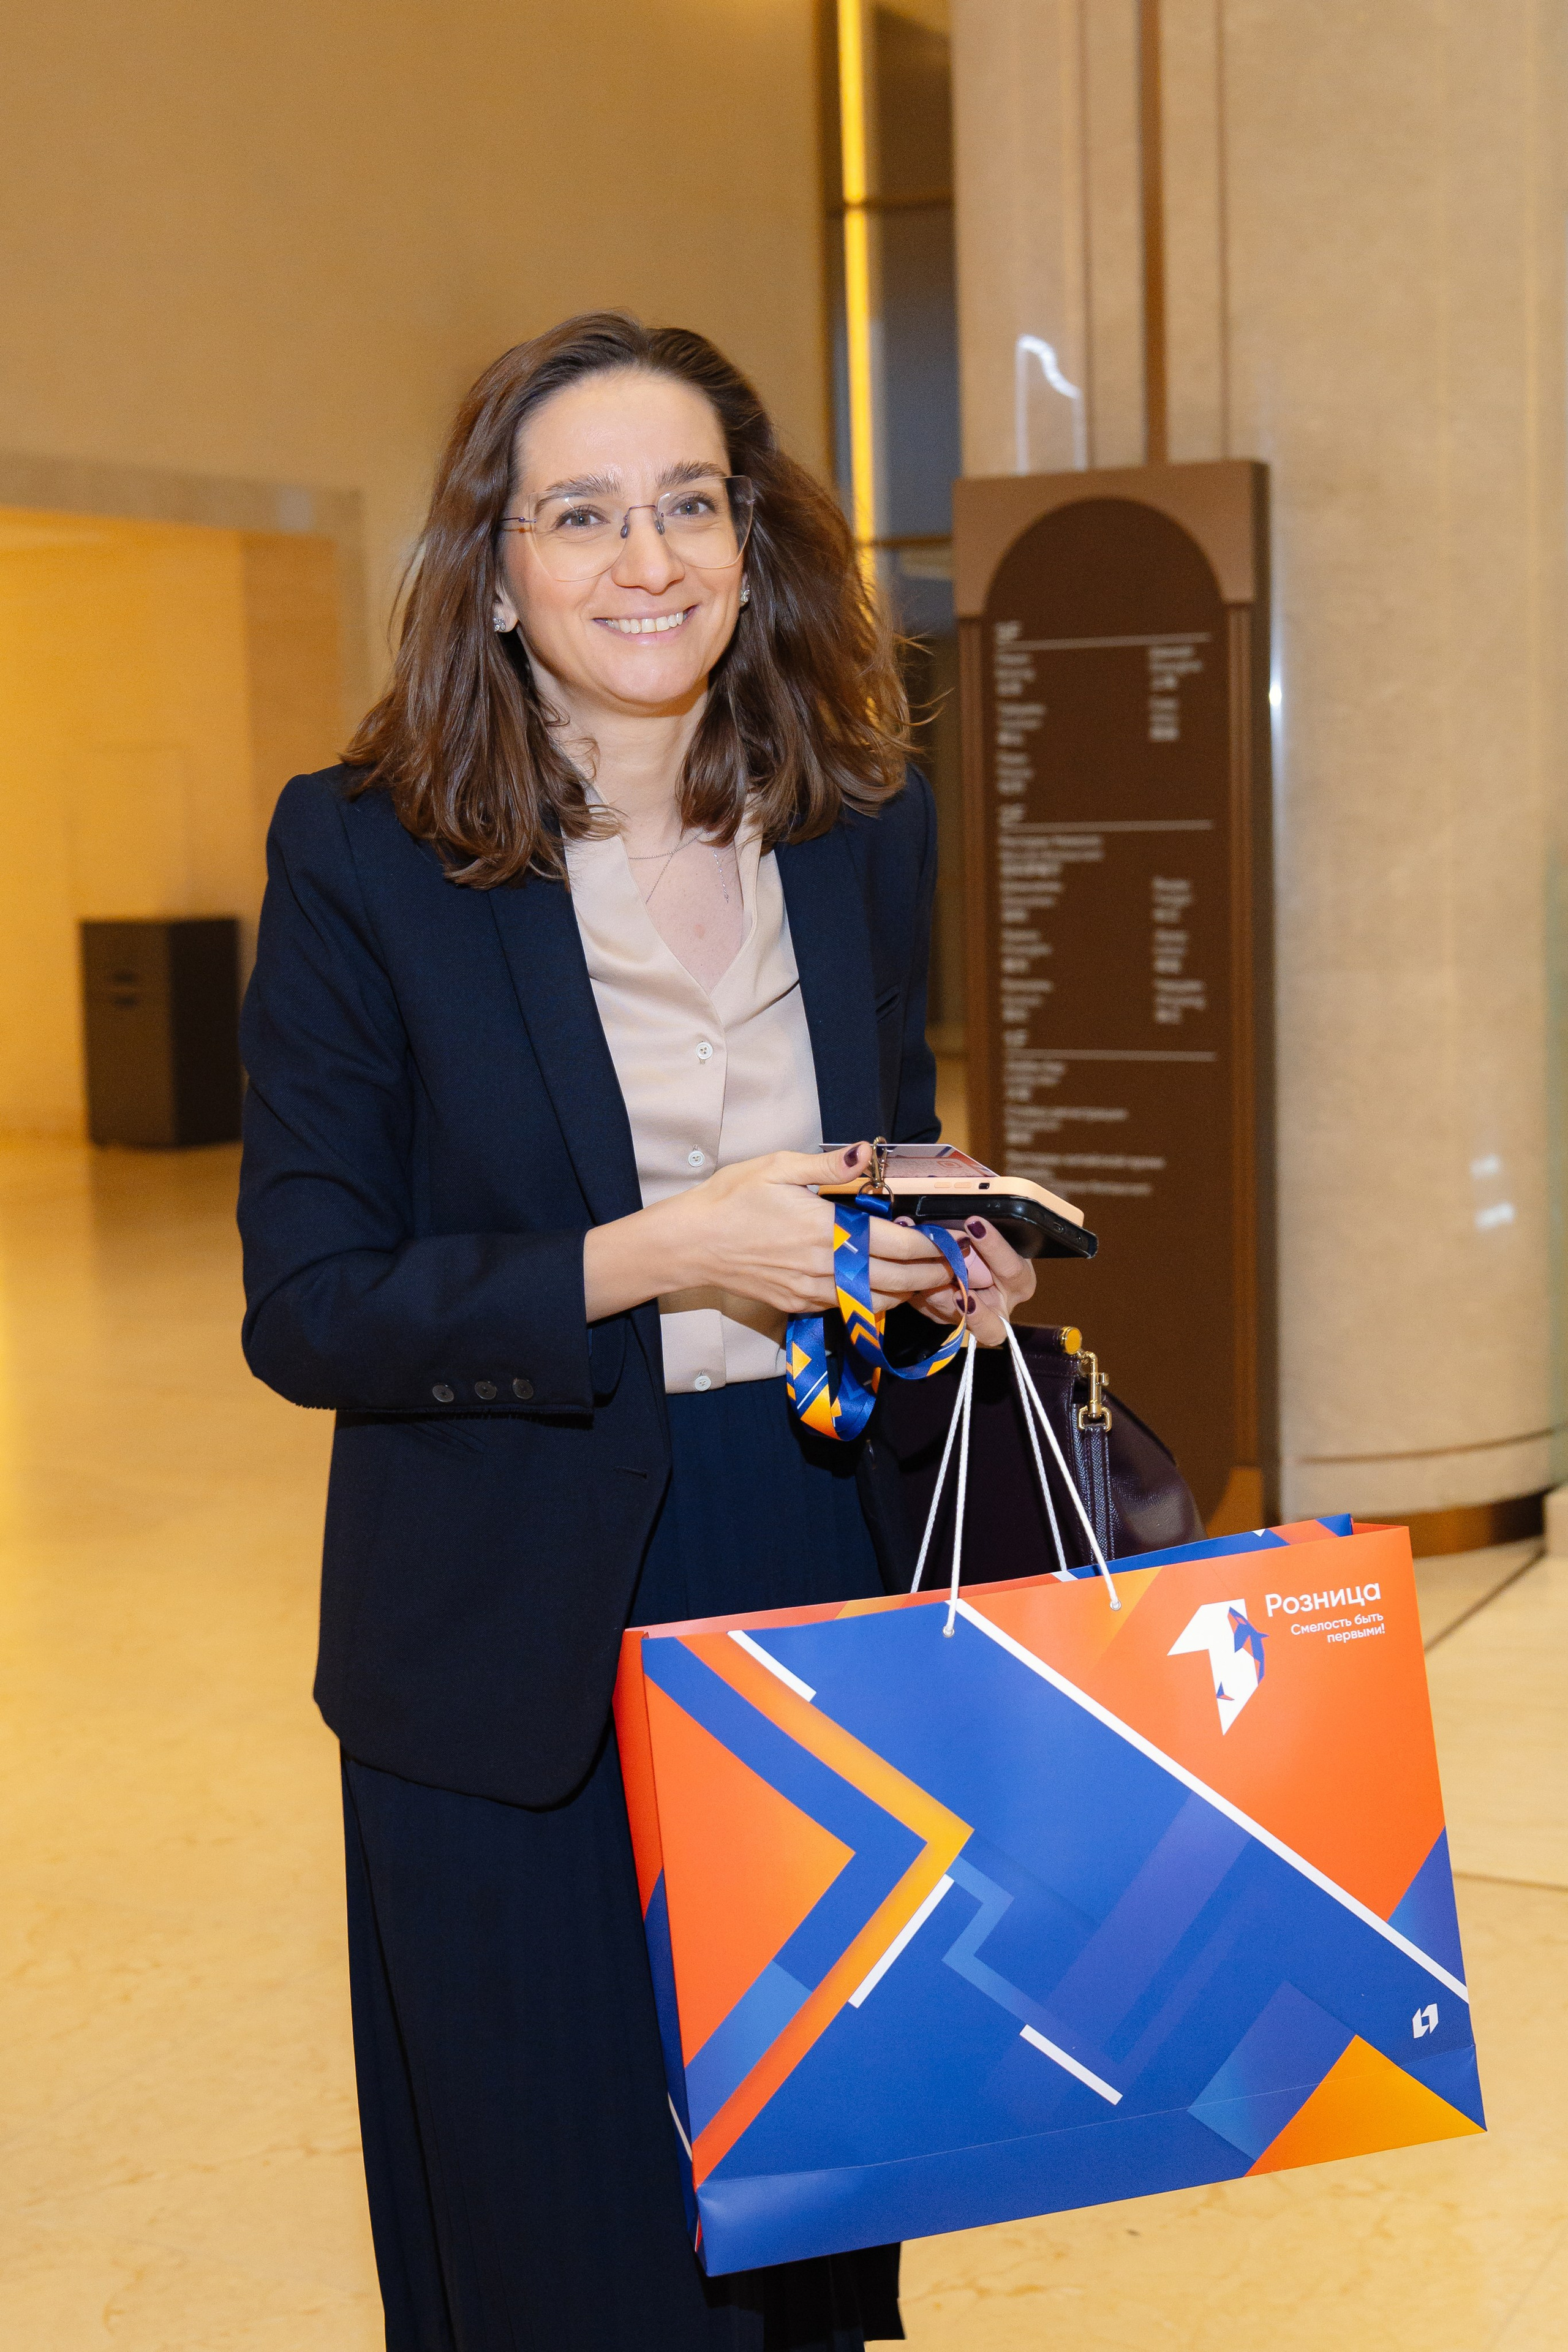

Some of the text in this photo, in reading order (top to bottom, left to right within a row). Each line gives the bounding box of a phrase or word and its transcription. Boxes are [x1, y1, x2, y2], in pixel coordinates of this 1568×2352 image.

[1265, 1583, 1381, 1618] Розница
[1291, 1613, 1384, 1635] Смелость быть
[1327, 1623, 1385, 1643] первыми!
